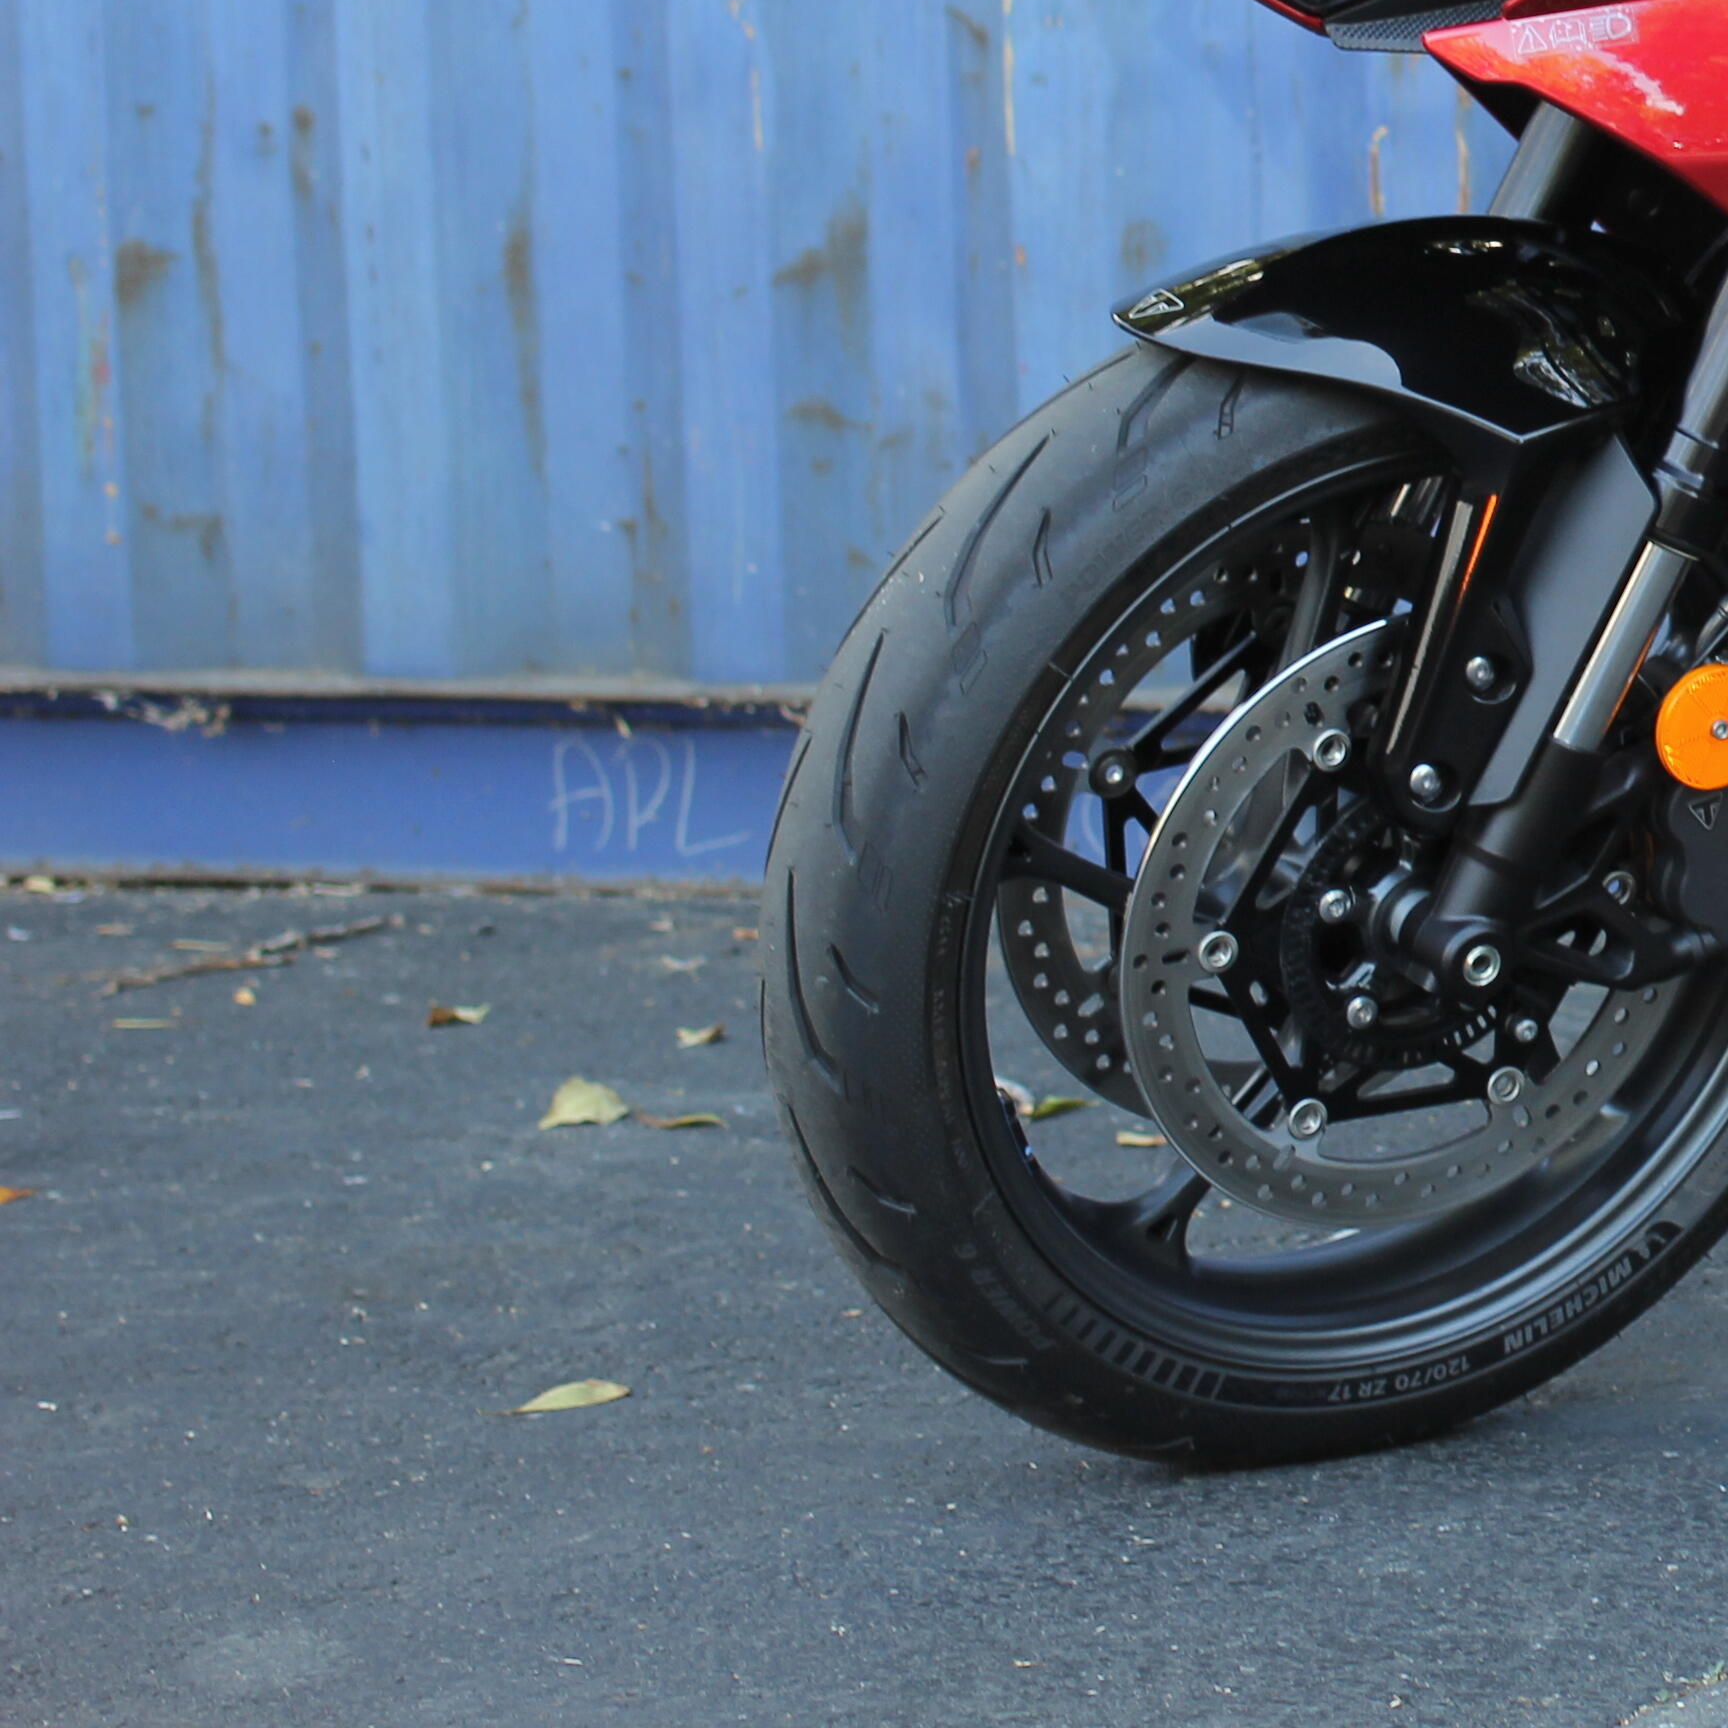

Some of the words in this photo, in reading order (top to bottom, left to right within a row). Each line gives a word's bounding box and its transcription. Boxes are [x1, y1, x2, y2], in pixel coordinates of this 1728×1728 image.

[548, 735, 752, 858] APL
[1503, 1256, 1633, 1354] MICHELIN
[1327, 1381, 1351, 1402] 17
[1358, 1379, 1389, 1398] ZR
[1395, 1355, 1472, 1392] 120/70
